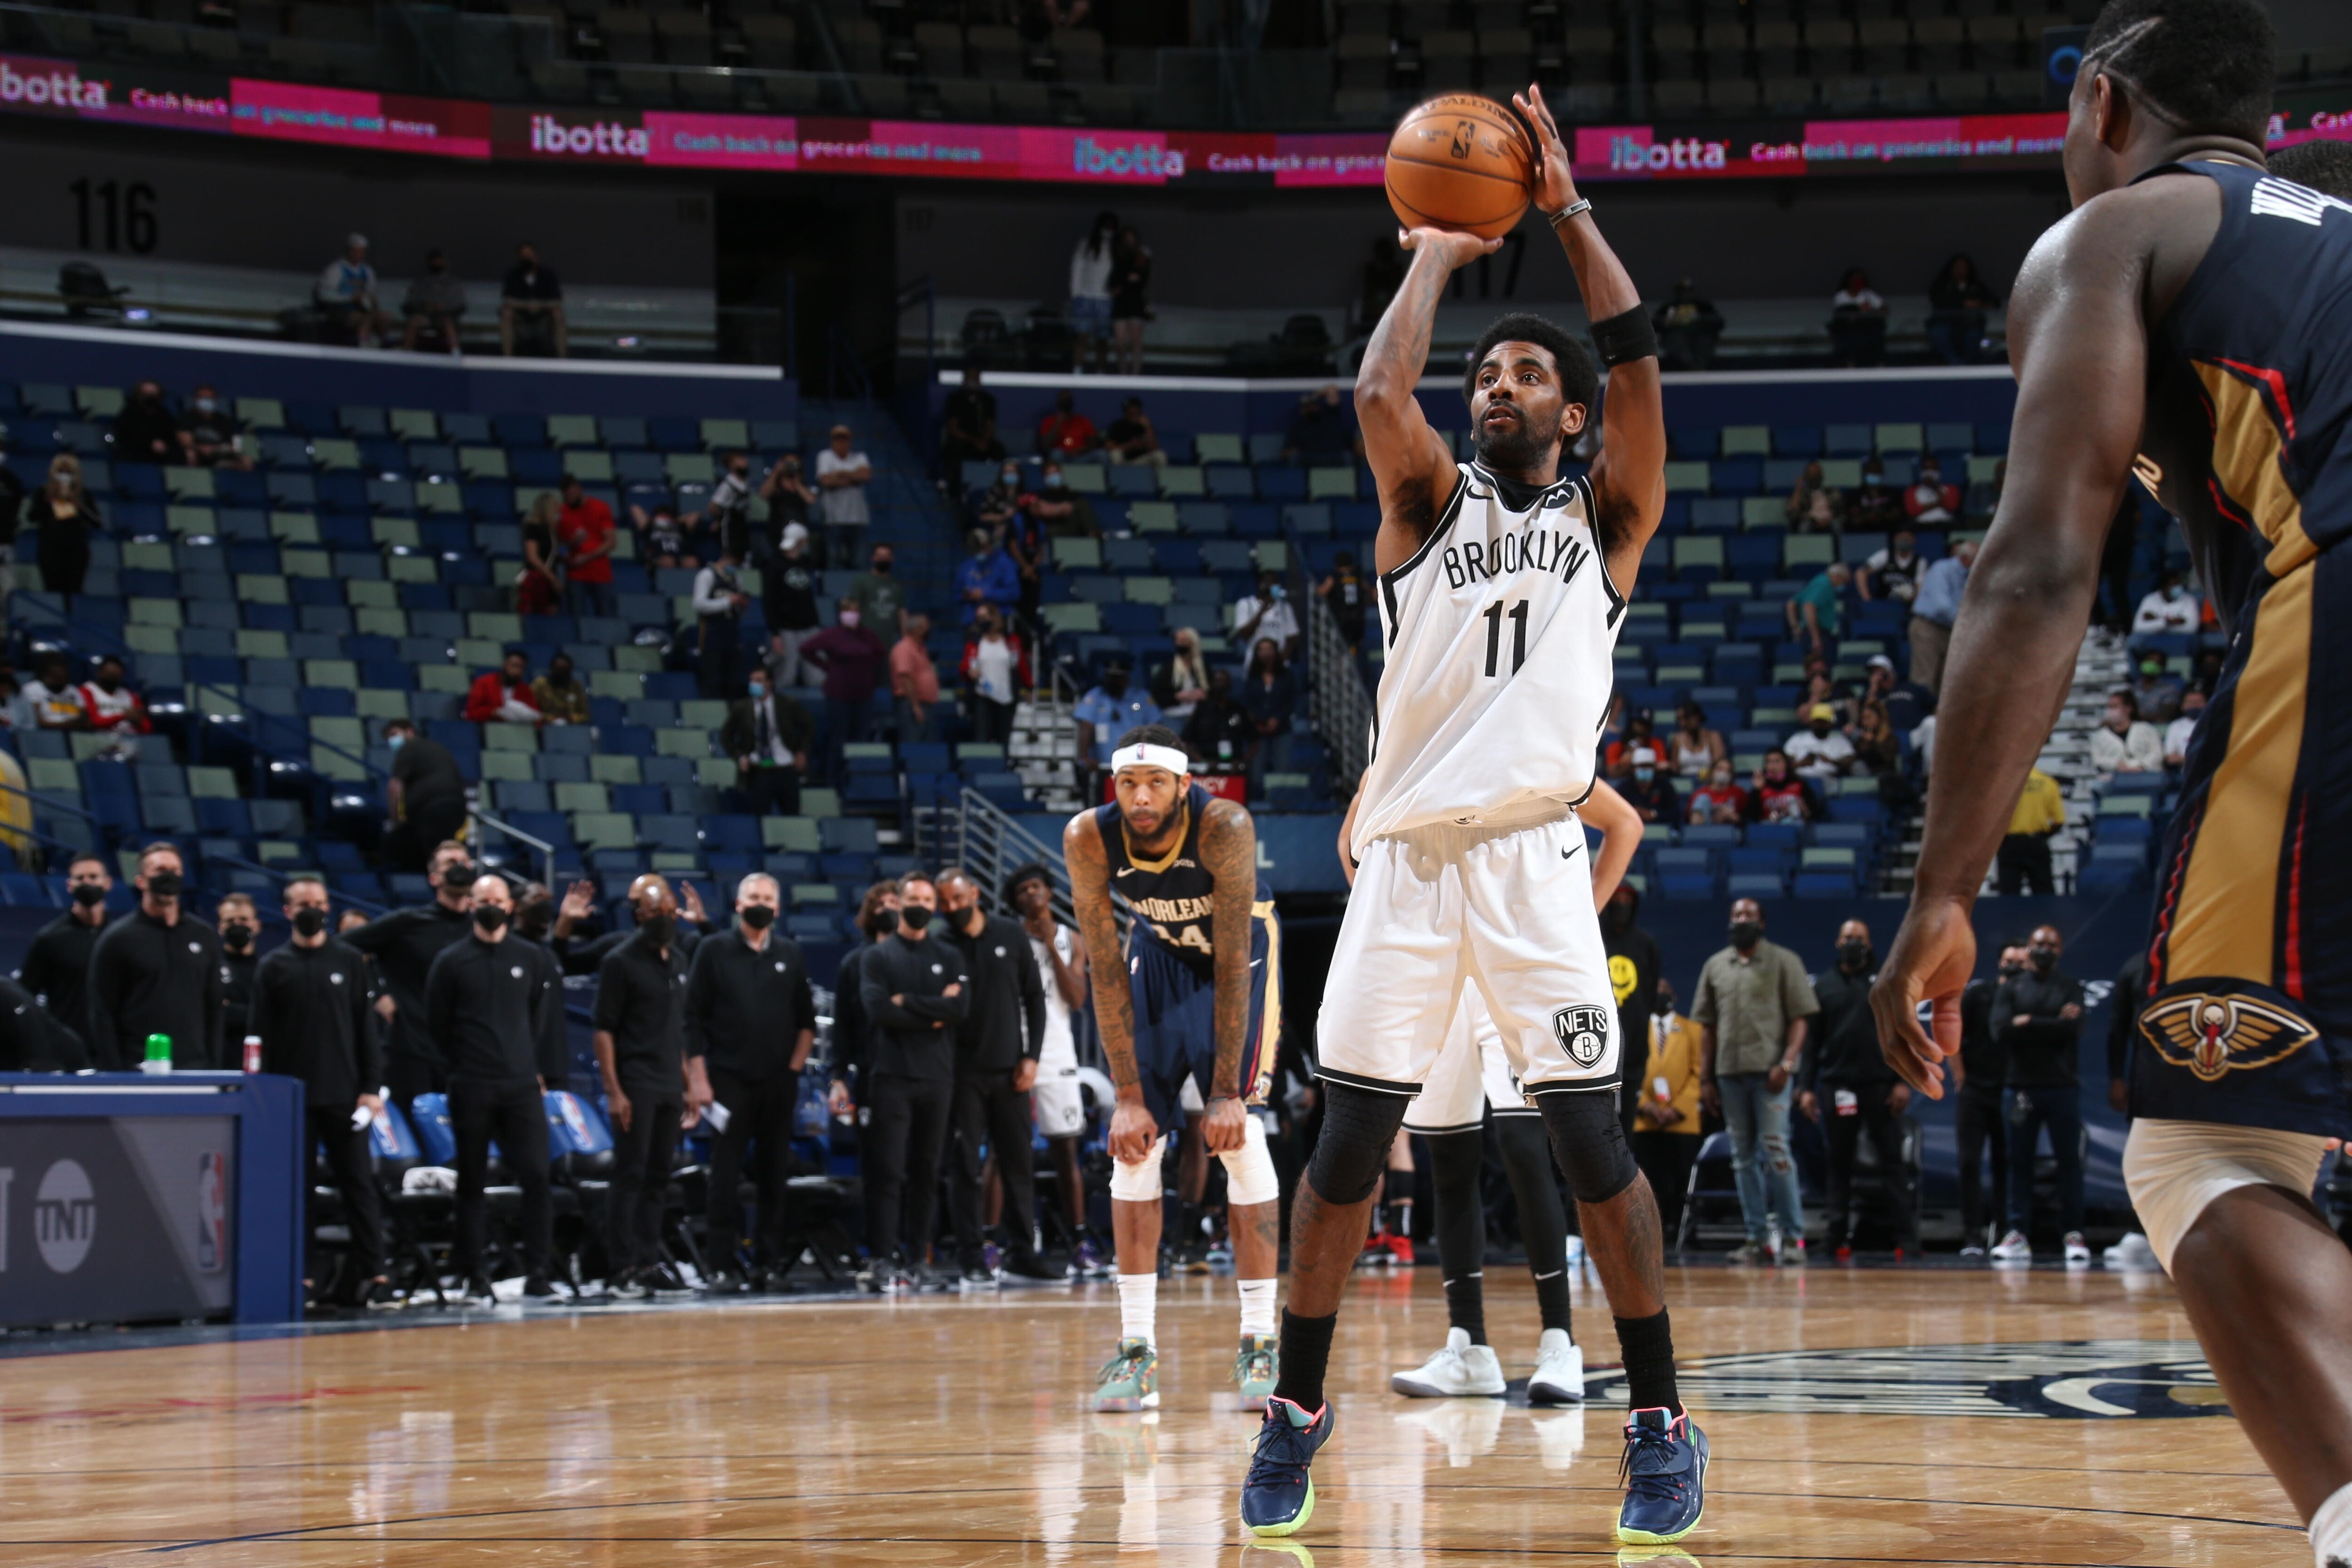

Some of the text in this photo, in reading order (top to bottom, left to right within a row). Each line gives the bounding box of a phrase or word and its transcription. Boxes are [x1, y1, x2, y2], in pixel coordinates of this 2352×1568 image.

[531, 114, 649, 156] ibotta
[1073, 135, 1185, 177] ibotta
[1610, 135, 1726, 171] ibotta
[70, 177, 159, 255] 116
[1443, 530, 1590, 589] BROOKLYN
[1483, 599, 1529, 677] 11
[1558, 1009, 1607, 1037] NETS
[1582, 1037, 1592, 1057] B
[37, 1200, 95, 1241] TNT
